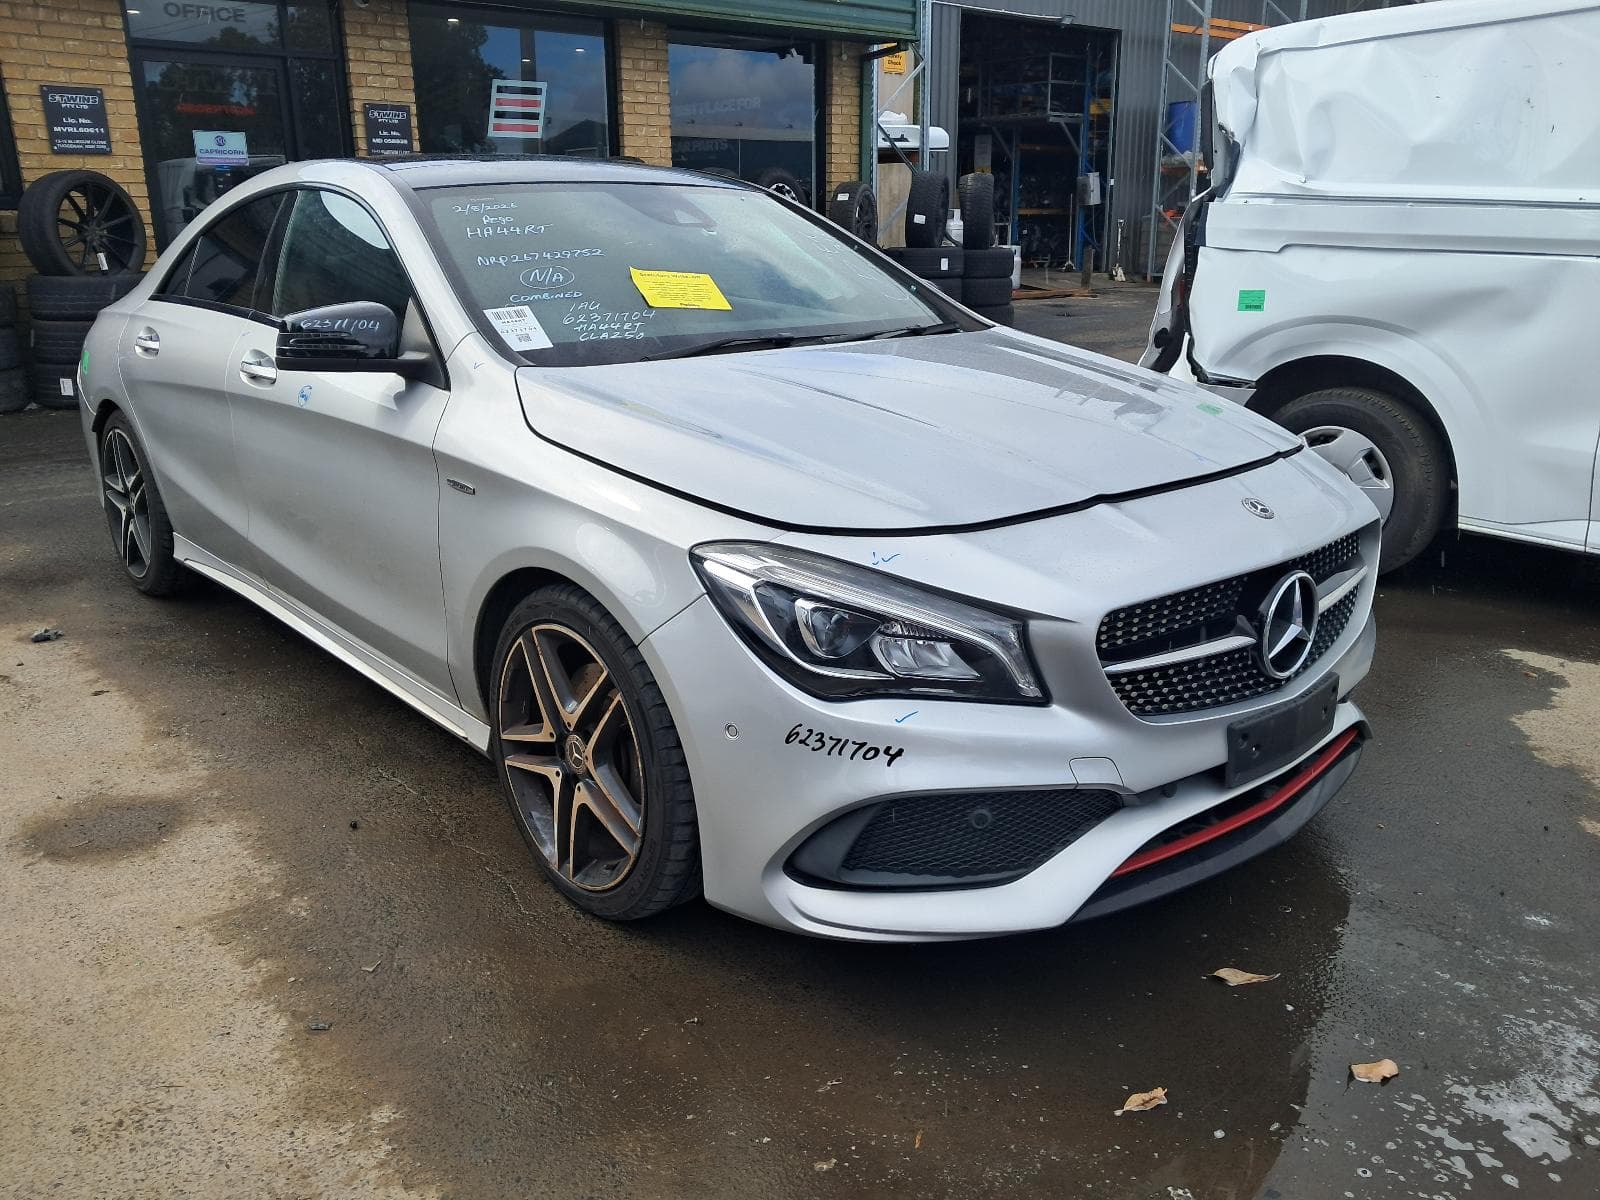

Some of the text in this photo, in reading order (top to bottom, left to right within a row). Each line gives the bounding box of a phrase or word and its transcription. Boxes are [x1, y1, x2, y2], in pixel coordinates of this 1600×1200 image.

[163, 2, 247, 23] OFFICE
[529, 267, 564, 285] N/A
[509, 291, 583, 302] COMBINED
[562, 309, 656, 325] 62371704
[784, 723, 905, 767] 62371704
